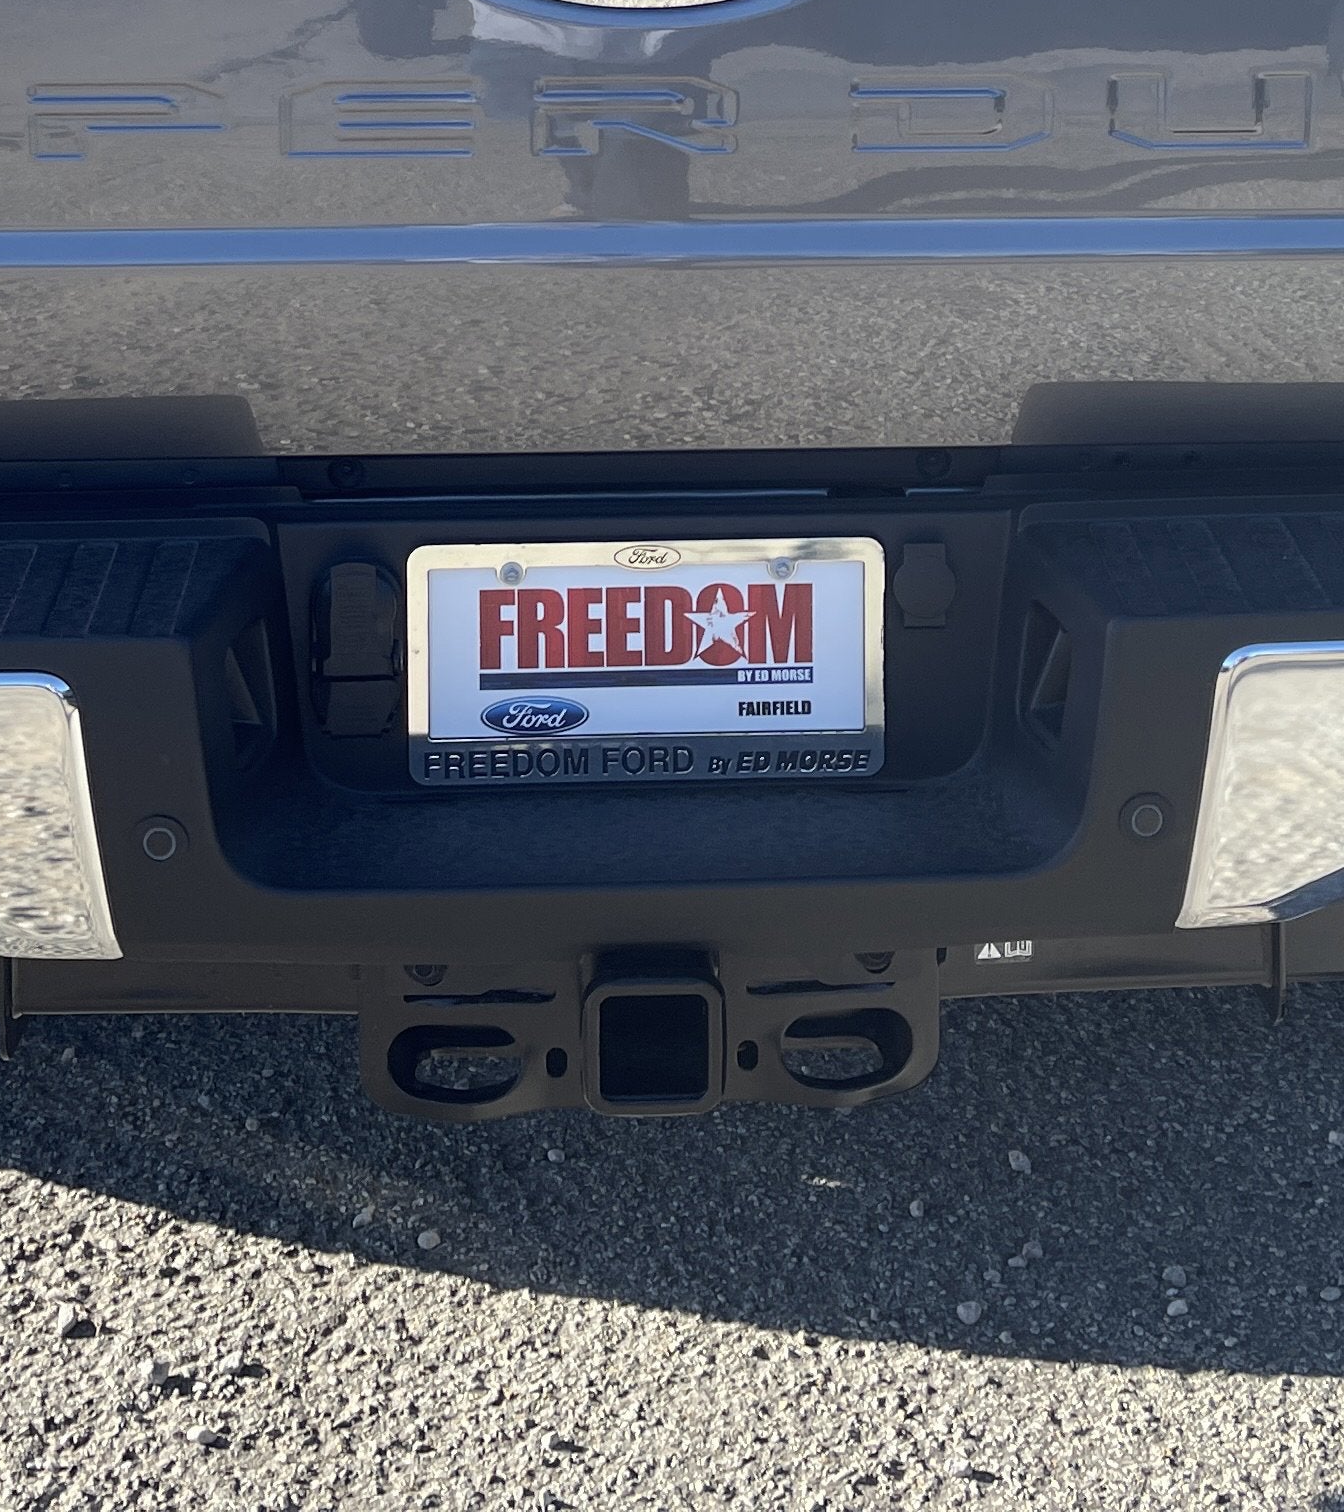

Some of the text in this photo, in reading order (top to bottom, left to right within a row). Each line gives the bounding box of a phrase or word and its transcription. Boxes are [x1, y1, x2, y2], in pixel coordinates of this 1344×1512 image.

[628, 547, 668, 565] Ford
[479, 583, 813, 670] FREEDOM
[737, 669, 811, 682] BY ED MORSE
[502, 702, 566, 728] Ford
[738, 700, 812, 716] FAIRFIELD
[424, 748, 589, 780] FREEDOM
[602, 745, 694, 776] FORD
[736, 751, 771, 773] ED
[776, 749, 871, 773] MORSE
